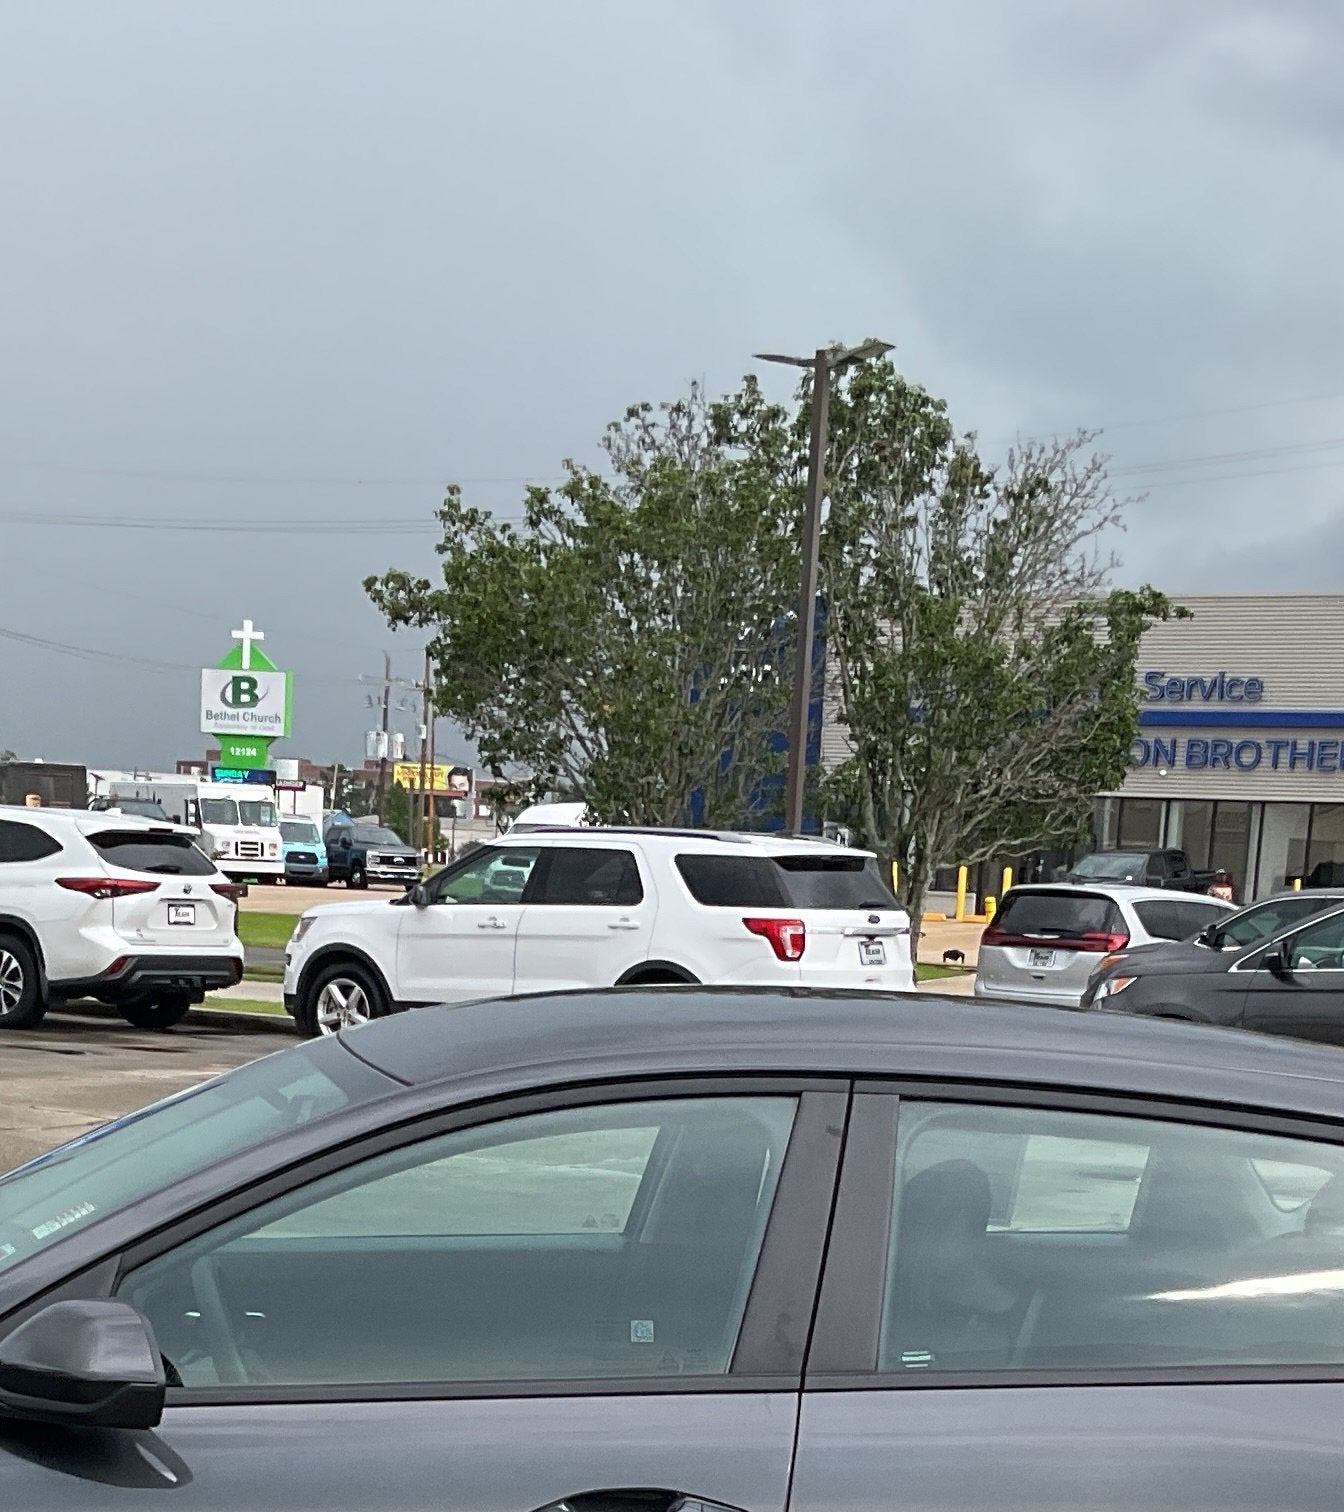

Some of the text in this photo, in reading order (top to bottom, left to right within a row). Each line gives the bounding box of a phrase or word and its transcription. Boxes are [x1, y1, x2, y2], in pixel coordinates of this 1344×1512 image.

[231, 675, 259, 704] B
[1144, 671, 1264, 701] Service
[205, 710, 281, 724] Bethel Church
